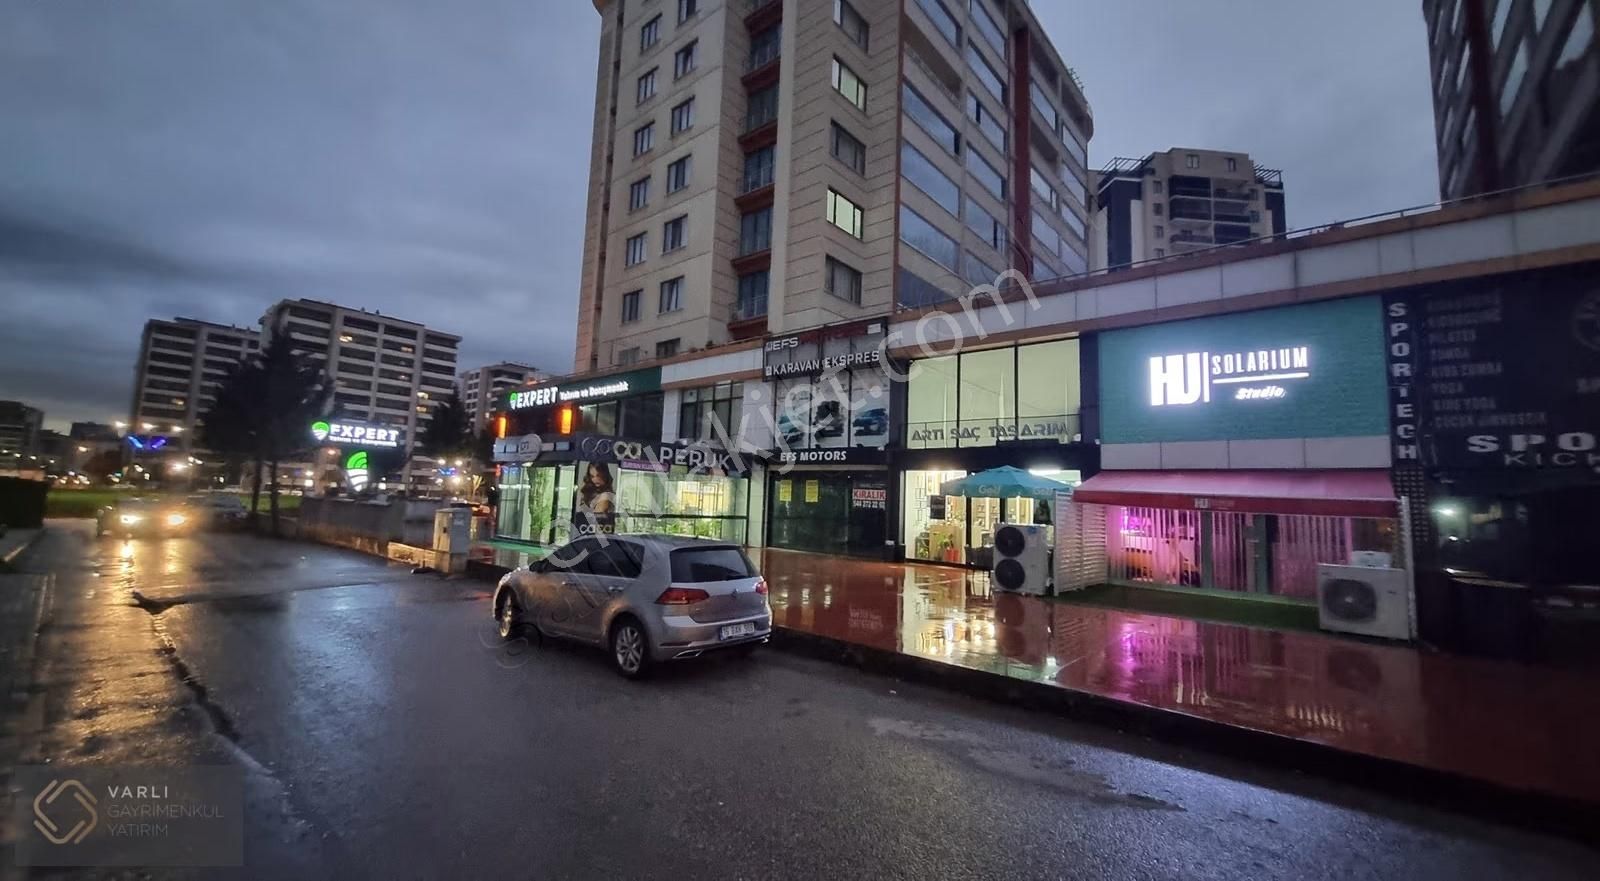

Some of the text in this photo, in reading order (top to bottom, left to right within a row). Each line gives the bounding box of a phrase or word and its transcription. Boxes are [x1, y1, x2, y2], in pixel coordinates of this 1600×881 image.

[773, 350, 880, 375] KARAVAN EKSPRES
[1212, 347, 1308, 375] SOLARIUM
[517, 387, 558, 409] EXPERT
[1235, 385, 1285, 399] Studio
[330, 423, 400, 442] EXPERT
[911, 422, 1068, 442] ARTI SAÇ TASARIM
[660, 446, 731, 470] PERUK
[780, 451, 847, 462] EFS MOTORS
